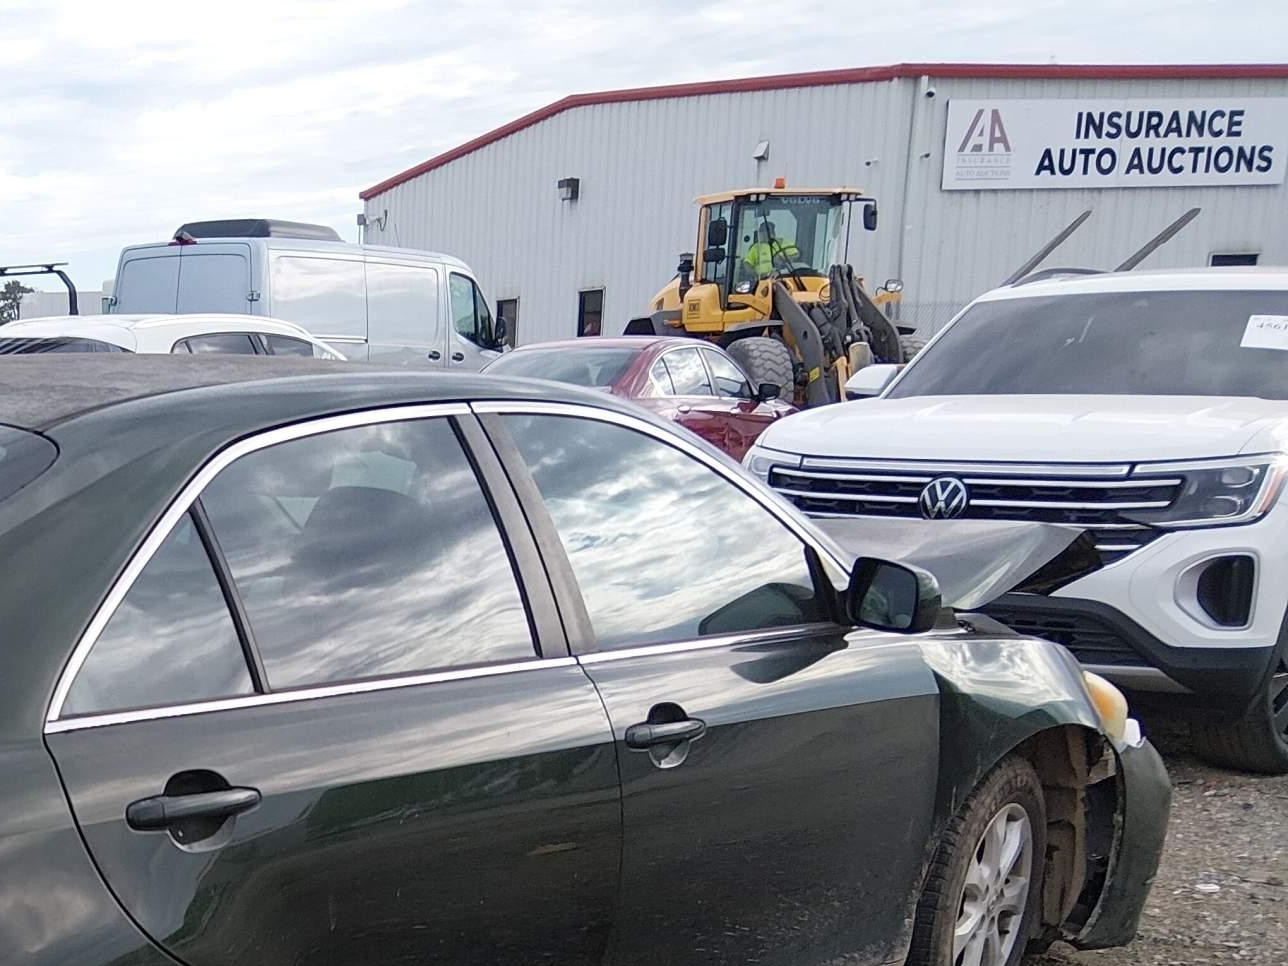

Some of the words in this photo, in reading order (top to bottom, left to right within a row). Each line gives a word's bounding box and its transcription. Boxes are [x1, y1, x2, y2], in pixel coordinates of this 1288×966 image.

[1075, 109, 1245, 140] INSURANCE
[1034, 147, 1117, 176] AUTO
[1124, 144, 1274, 175] AUCTIONS
